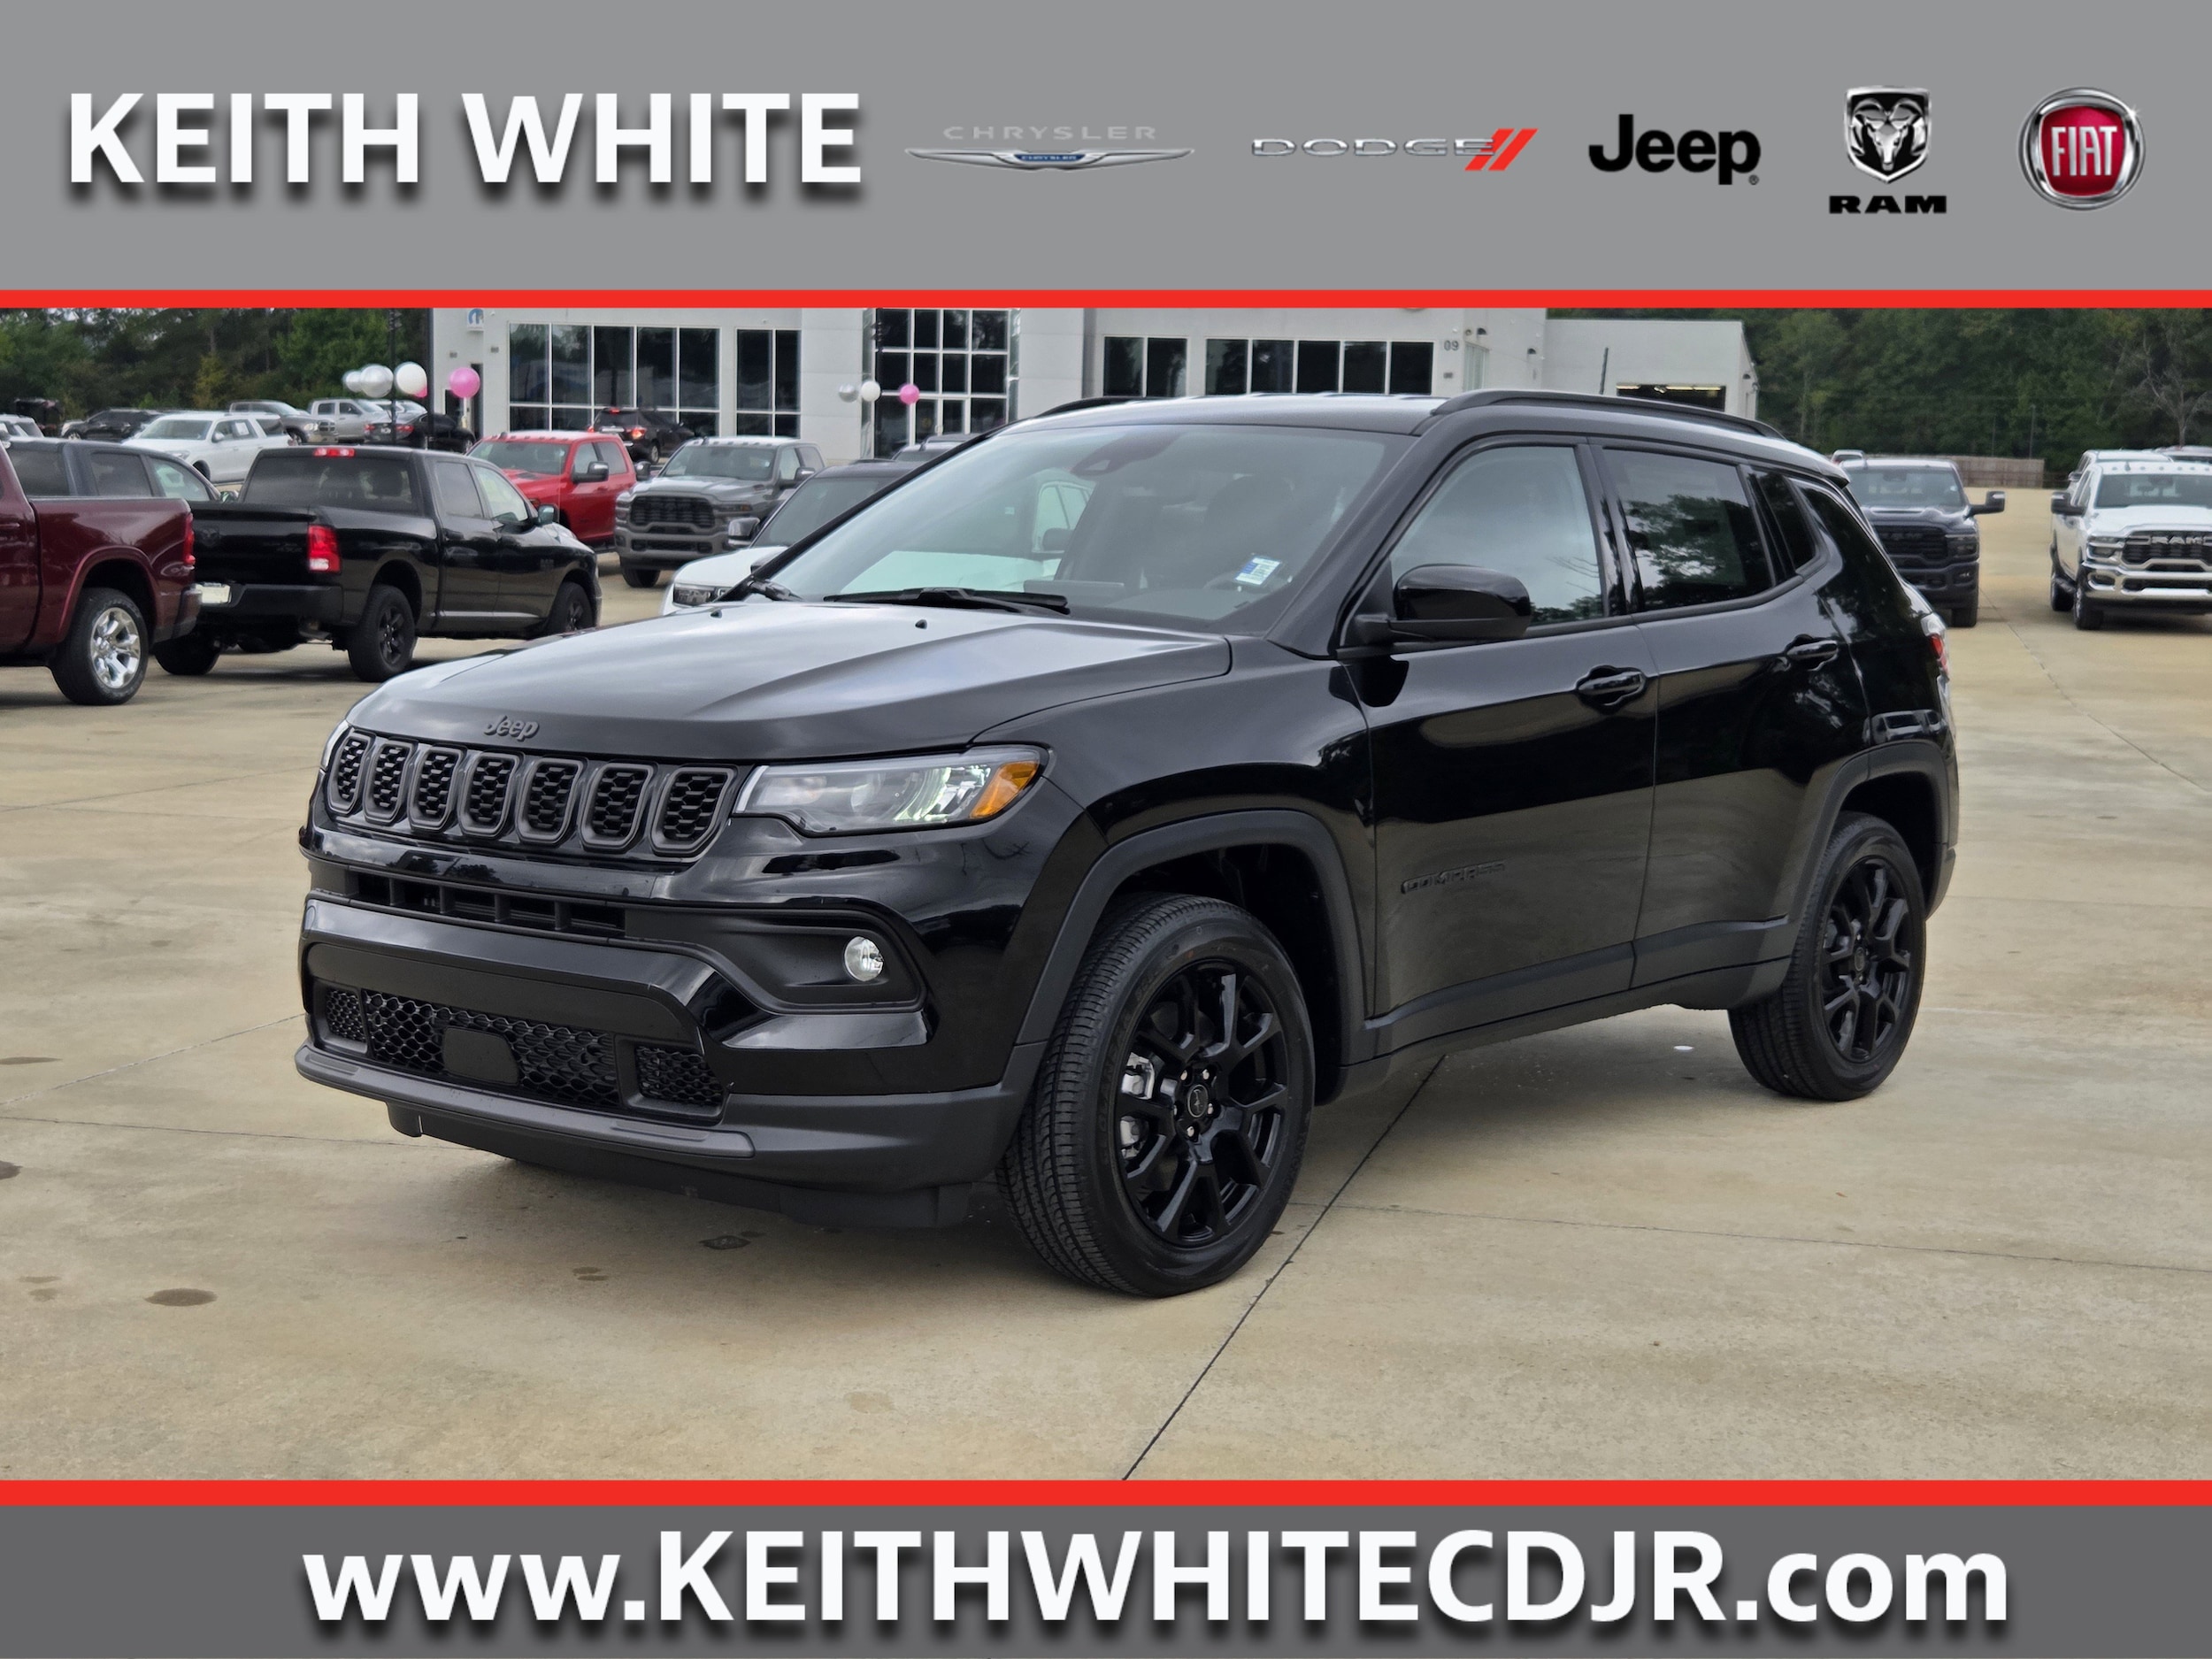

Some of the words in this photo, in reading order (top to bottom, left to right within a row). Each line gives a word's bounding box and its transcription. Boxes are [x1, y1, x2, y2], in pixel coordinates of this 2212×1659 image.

[1443, 340, 1459, 351] 09
[2151, 535, 2203, 546] RAM
[483, 714, 540, 742] Jeep
